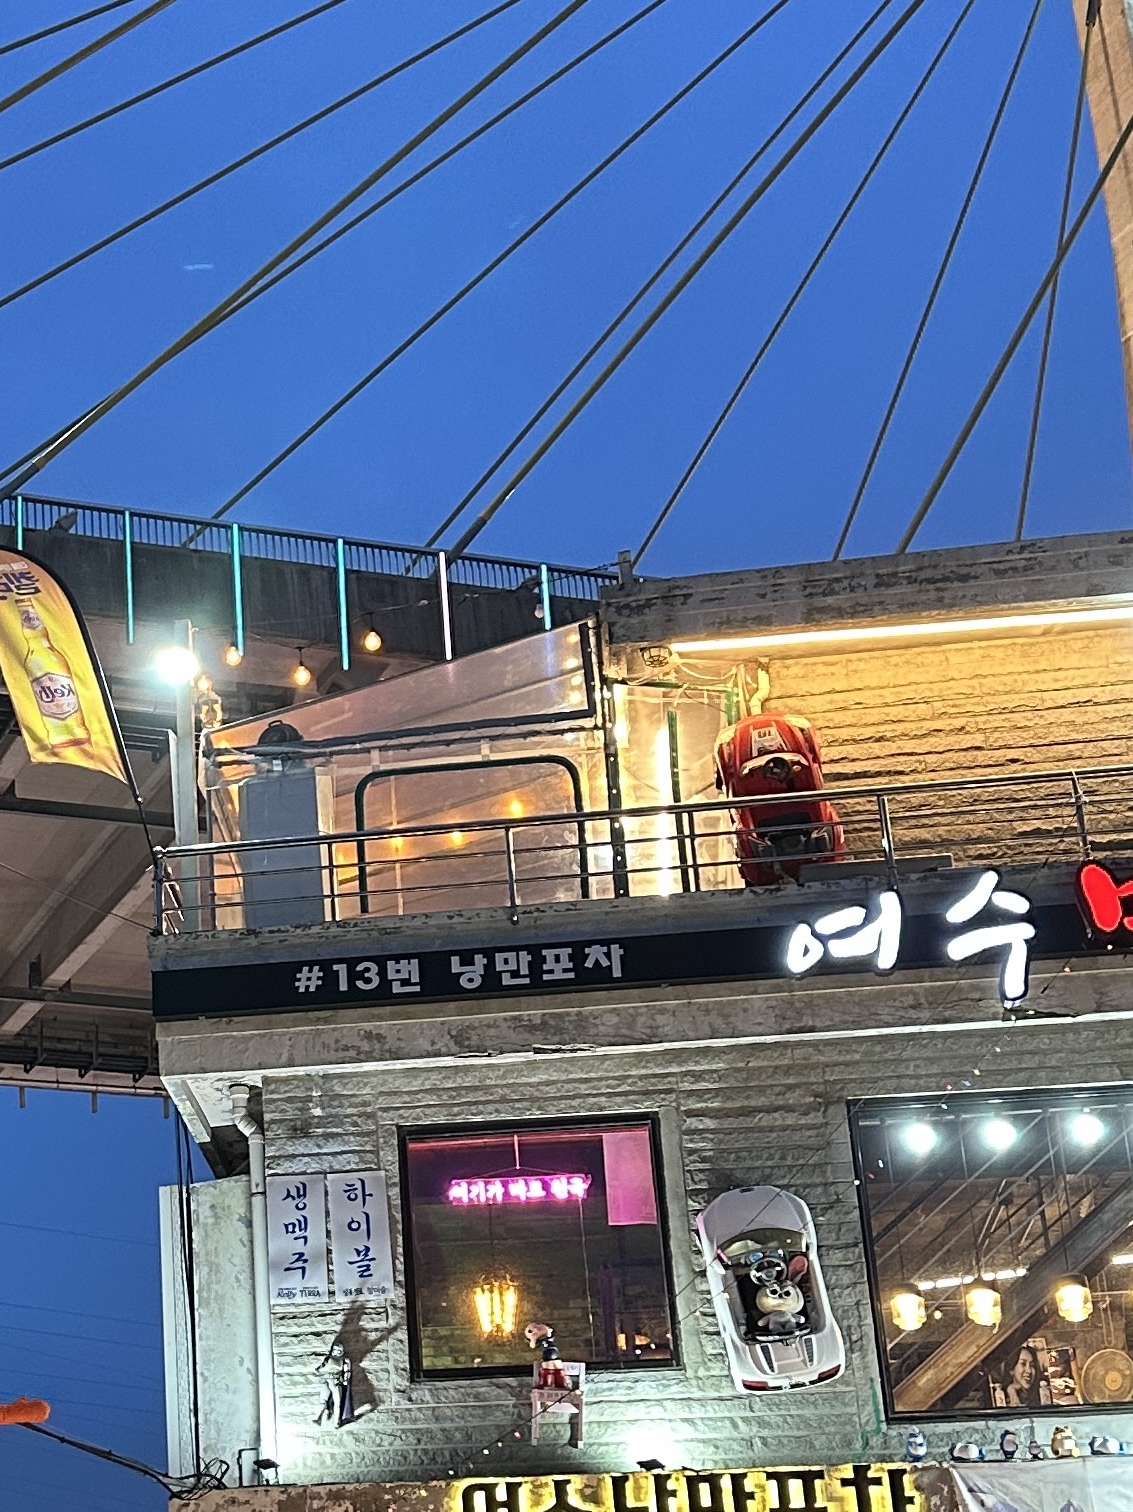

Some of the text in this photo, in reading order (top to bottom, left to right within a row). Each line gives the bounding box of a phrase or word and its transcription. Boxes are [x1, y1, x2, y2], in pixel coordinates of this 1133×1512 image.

[294, 945, 624, 993] #13번 낭만포차
[788, 870, 1036, 1001] 여수
[282, 1181, 309, 1280] 생맥주
[343, 1177, 377, 1278] 하이볼
